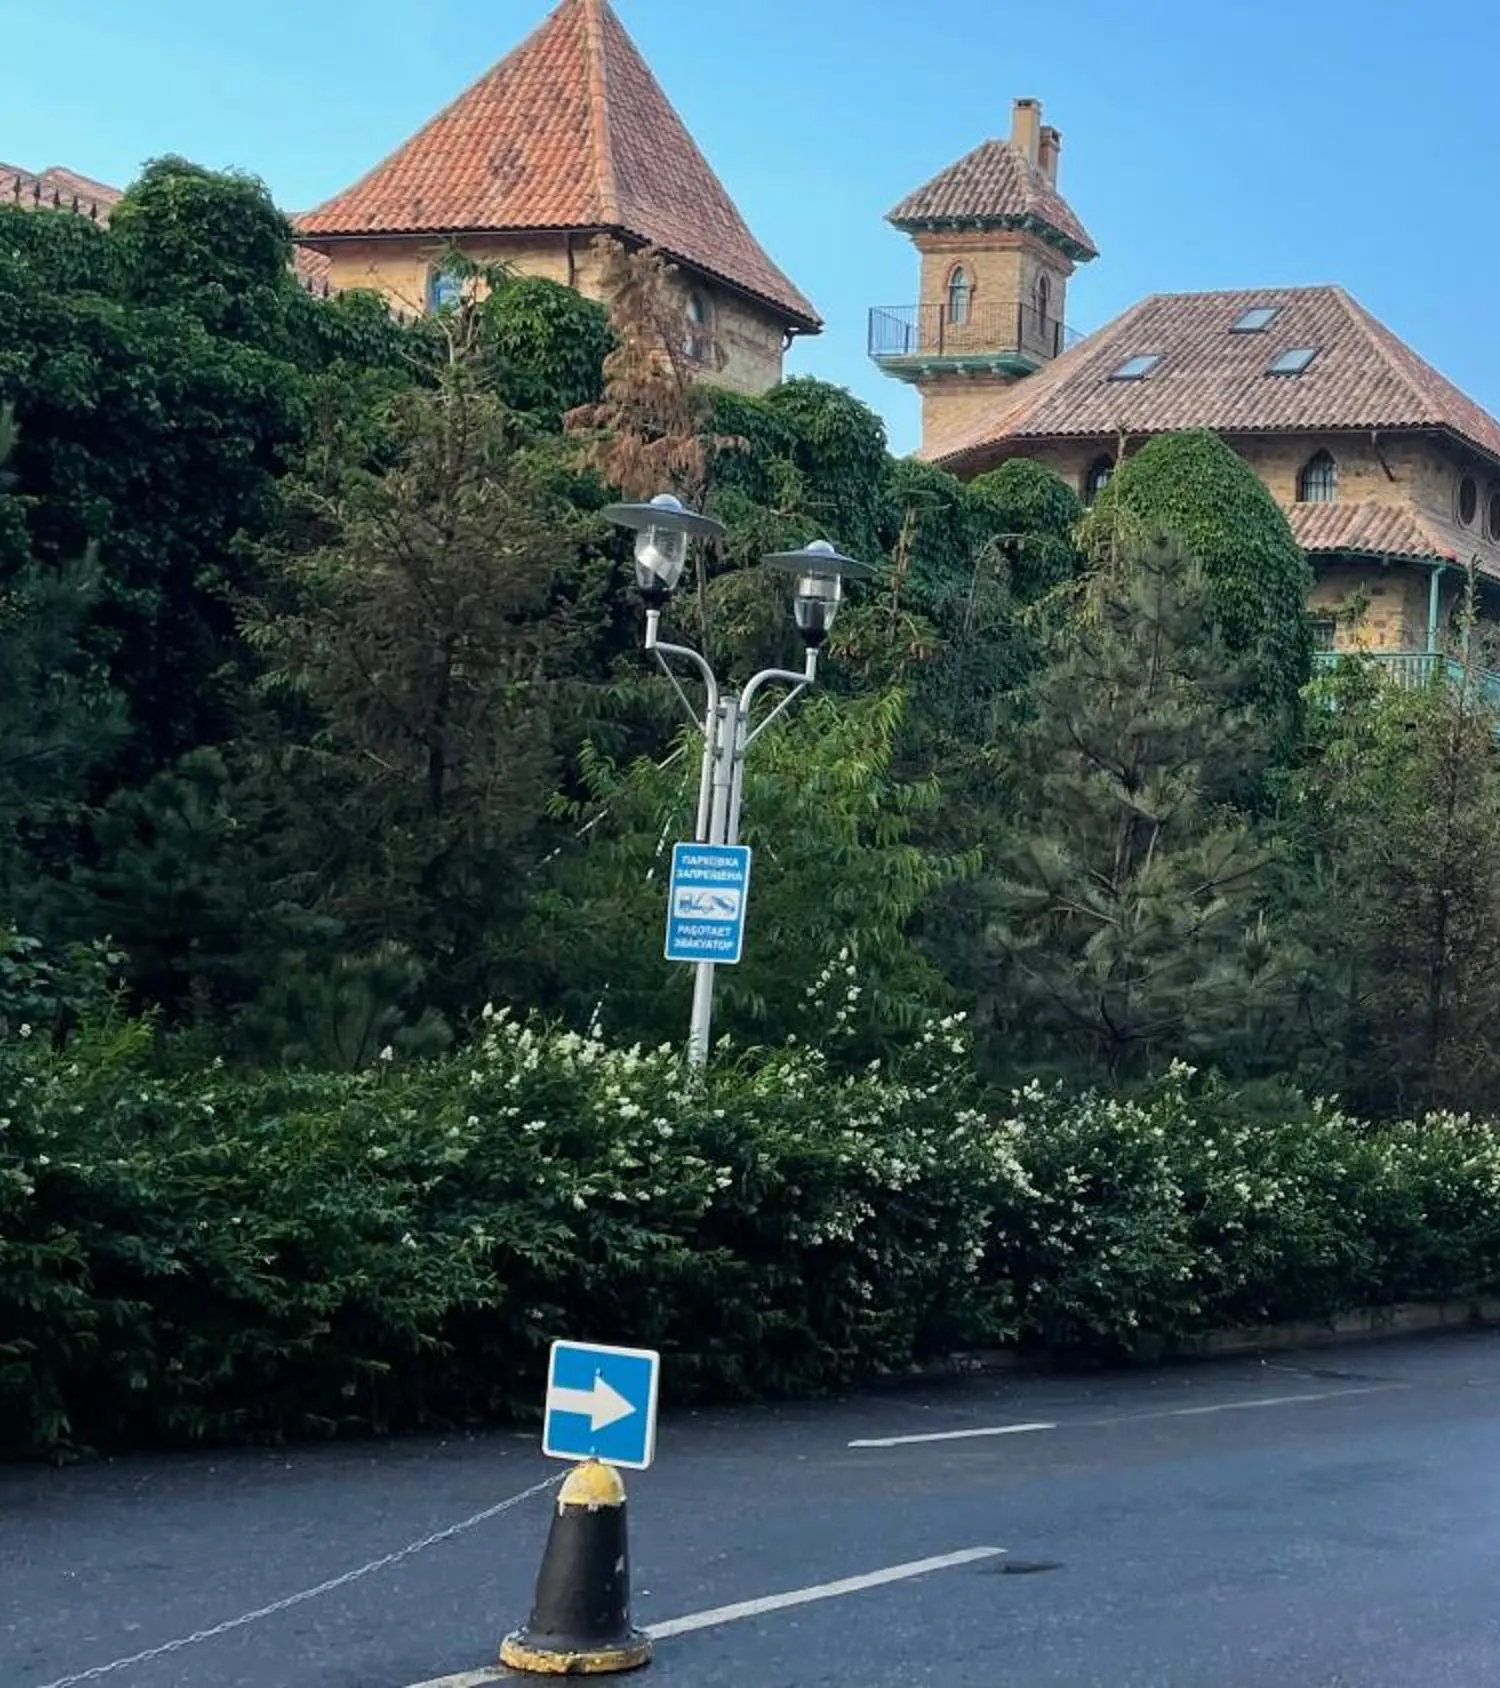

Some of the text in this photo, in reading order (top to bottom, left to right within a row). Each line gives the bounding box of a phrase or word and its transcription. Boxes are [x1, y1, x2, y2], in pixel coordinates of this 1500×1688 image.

[681, 855, 739, 867] ПАРКОВКА
[676, 869, 743, 881] ЗАПРЕЩЕНА
[677, 925, 732, 937] РАБОТАЕТ
